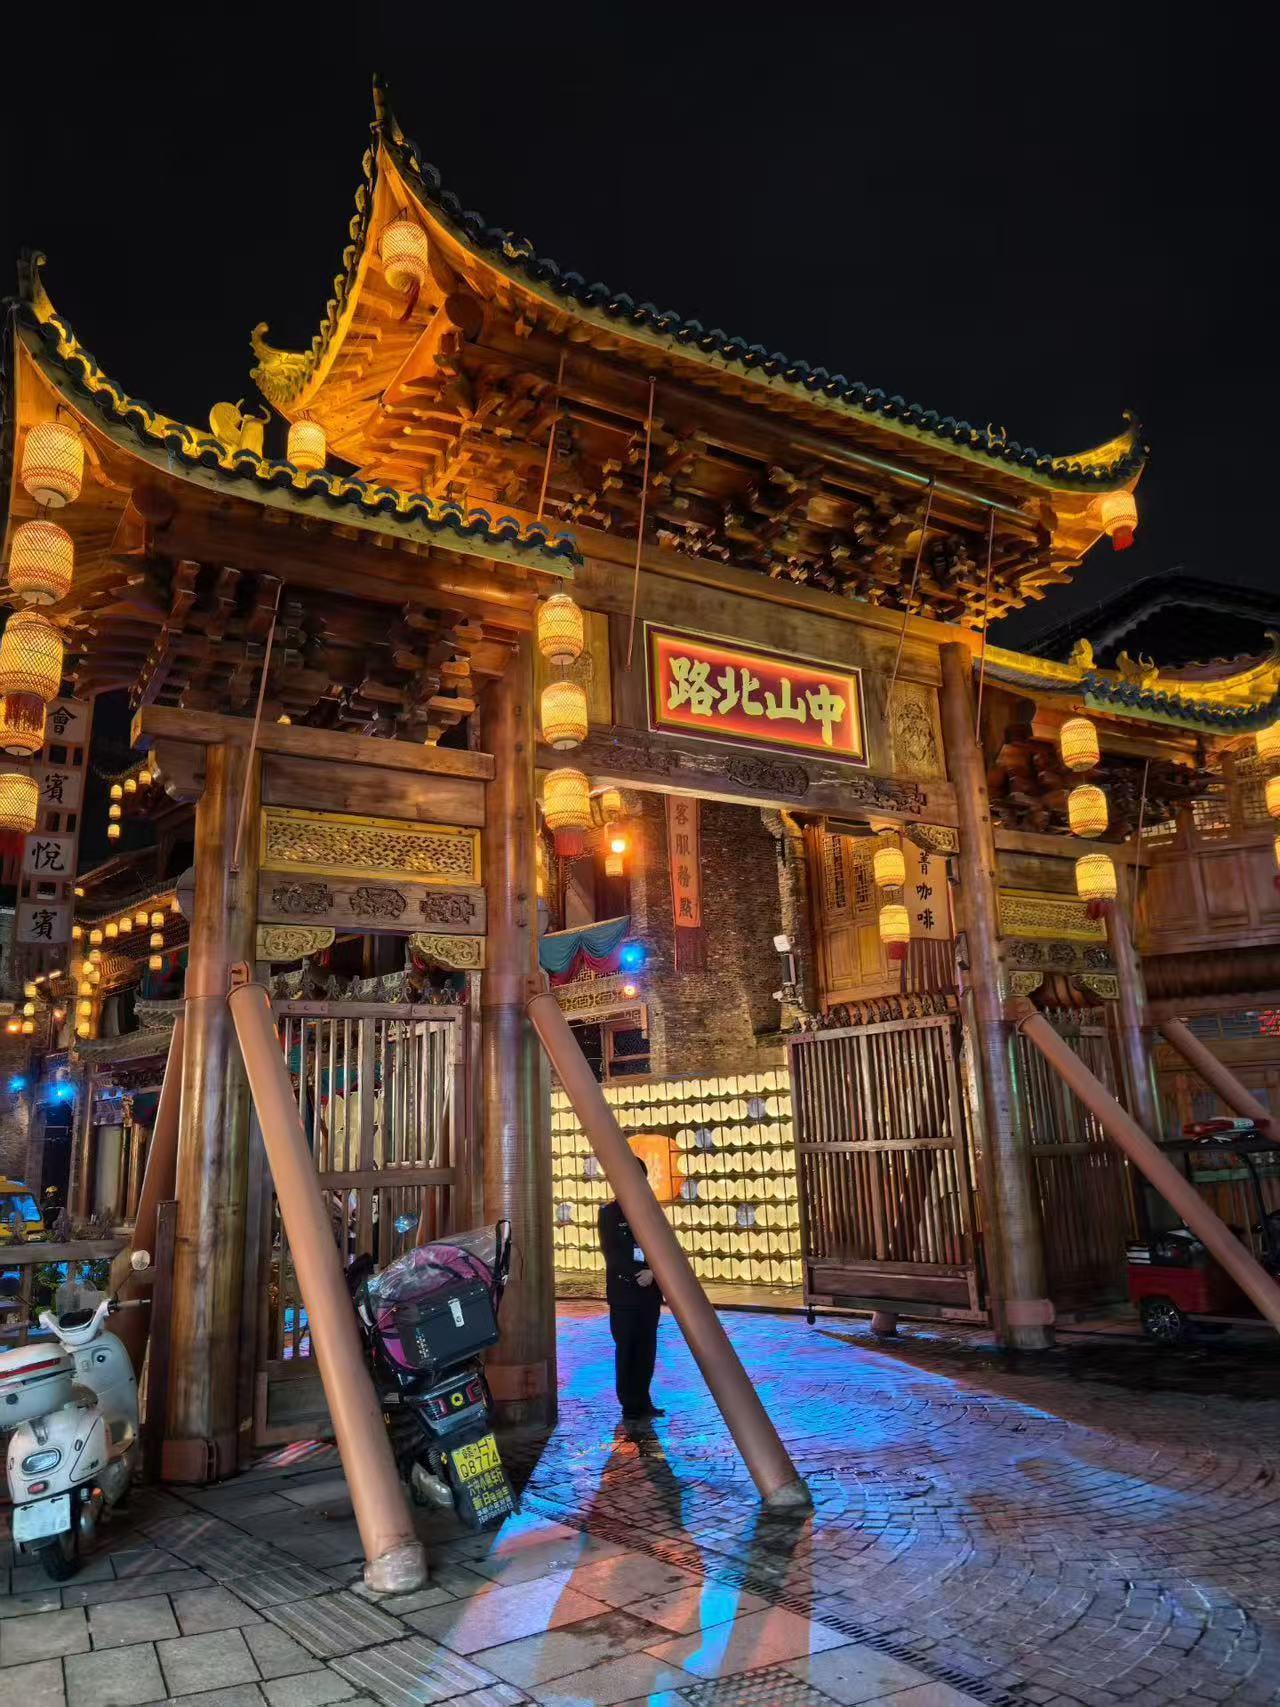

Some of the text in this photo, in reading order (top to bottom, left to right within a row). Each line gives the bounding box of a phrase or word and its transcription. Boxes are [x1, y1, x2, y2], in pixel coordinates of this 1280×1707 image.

[668, 657, 846, 746] 中山北路
[460, 1449, 499, 1478] Q8774
